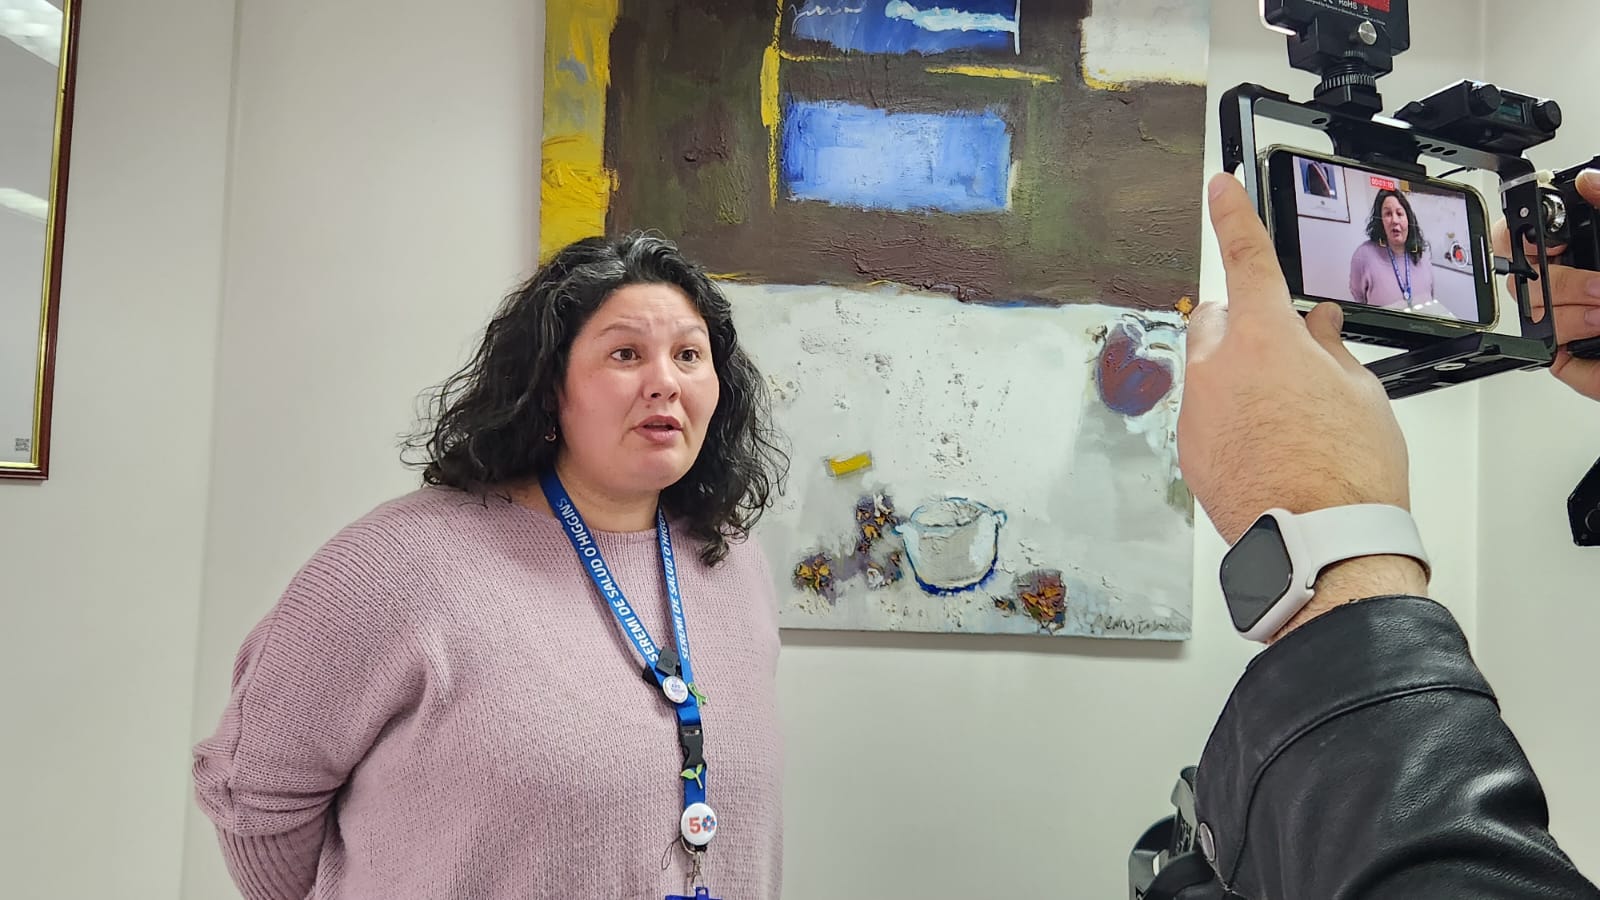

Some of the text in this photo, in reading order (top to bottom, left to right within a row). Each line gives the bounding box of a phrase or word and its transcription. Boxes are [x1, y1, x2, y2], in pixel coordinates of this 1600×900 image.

[557, 498, 659, 663] SEREMI DE SALUD O'HIGGINS
[664, 558, 678, 598] SALUD
[670, 598, 682, 616] DE
[676, 613, 690, 661] SEREMI
